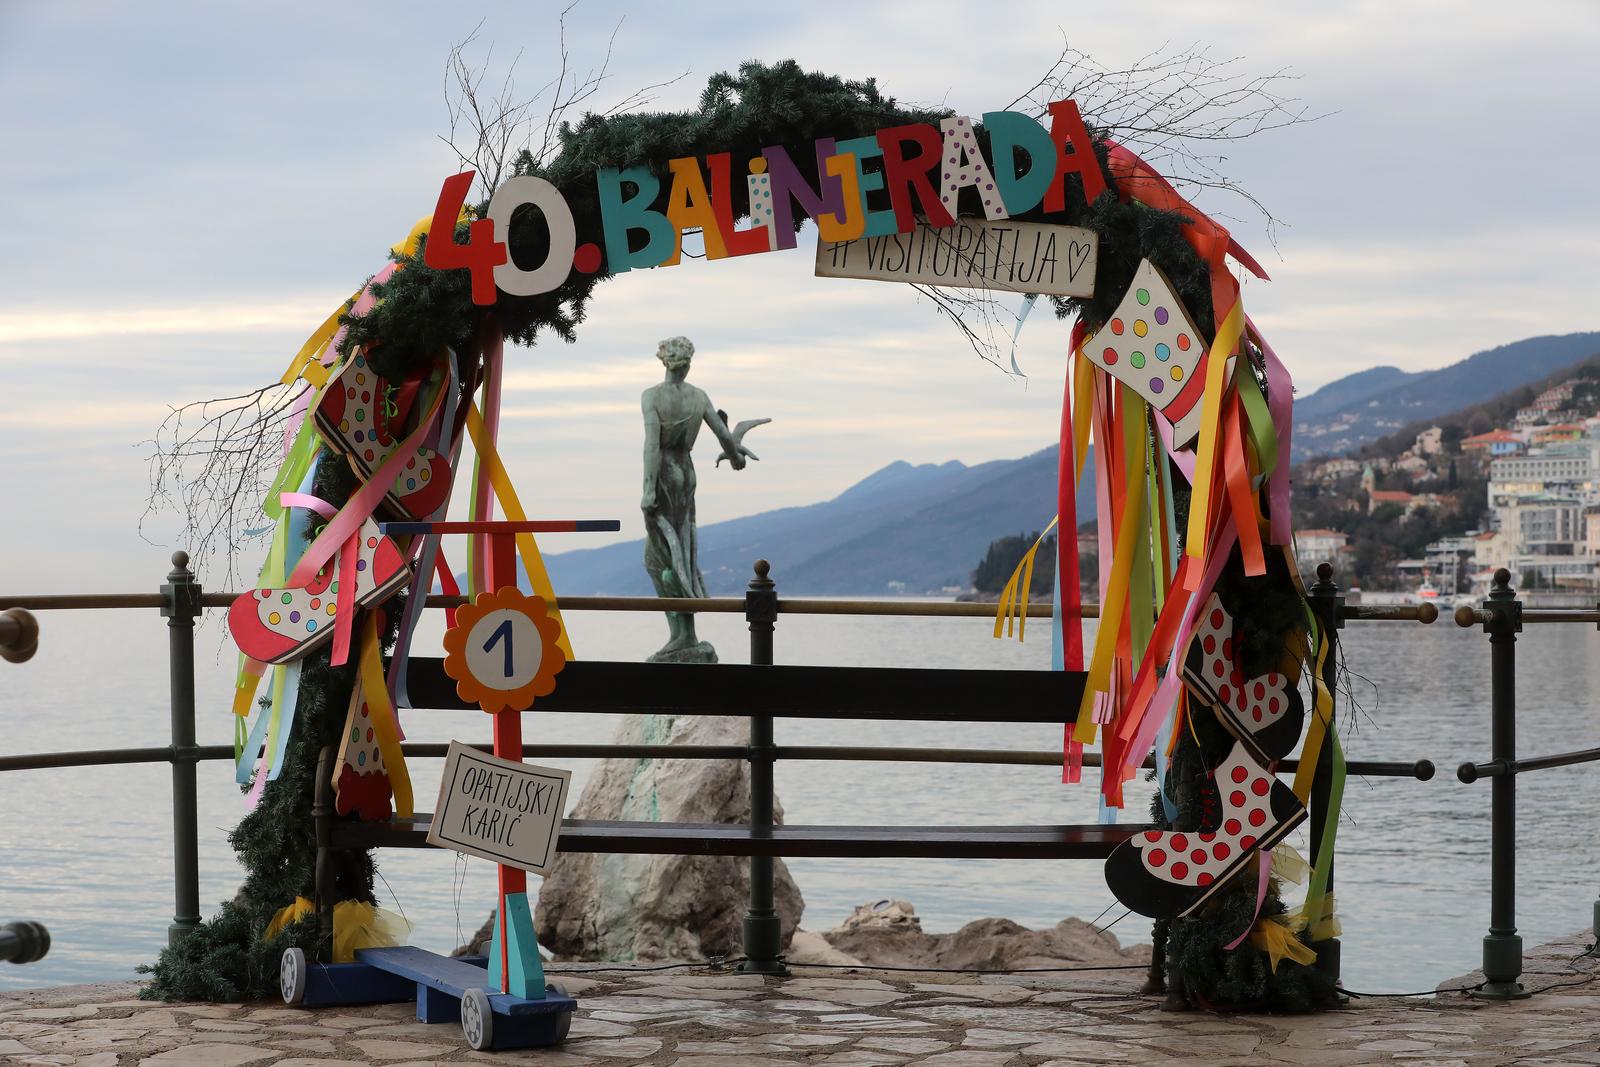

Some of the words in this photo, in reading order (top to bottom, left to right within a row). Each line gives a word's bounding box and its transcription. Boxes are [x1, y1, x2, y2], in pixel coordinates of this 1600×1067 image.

[424, 170, 602, 305] 40.
[482, 620, 513, 677] 1
[462, 767, 553, 815] OPATIJSKI
[462, 804, 522, 847] KARIĆ
